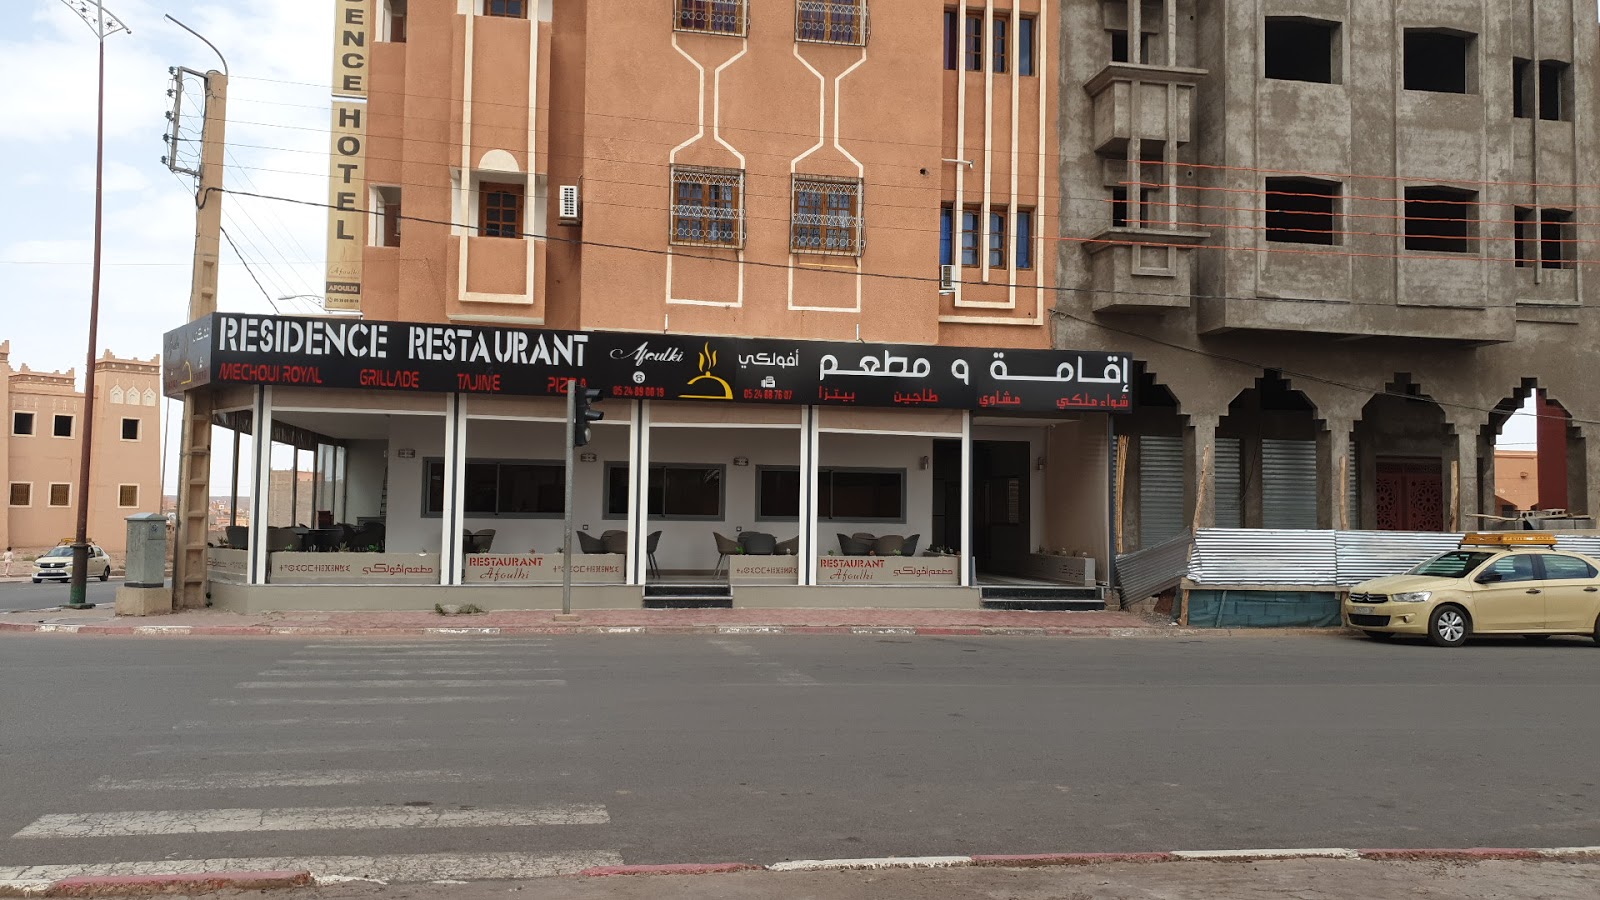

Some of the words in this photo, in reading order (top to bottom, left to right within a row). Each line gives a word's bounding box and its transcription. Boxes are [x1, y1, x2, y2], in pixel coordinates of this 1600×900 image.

[342, 0, 364, 91] ENCE
[336, 107, 361, 240] HOTEL
[219, 317, 388, 359] RESIDENCE
[408, 326, 589, 367] RESTAURANT
[738, 348, 799, 369] أفولكي
[819, 350, 931, 381] مطعم
[219, 362, 280, 381] MECHOUI
[283, 365, 323, 384] ROYAL
[360, 368, 419, 388] GRILLADE
[951, 358, 969, 386] و
[457, 373, 501, 391] TAJINE
[743, 388, 753, 399] 05
[818, 385, 856, 402] بيتزا
[893, 388, 939, 403] طاجين
[979, 389, 1021, 408] مشاوي
[1056, 392, 1098, 409] ملكي
[1099, 393, 1129, 409] شواء
[404, 564, 433, 576] مطعم
[469, 557, 543, 567] RESTAURANT
[820, 559, 885, 568] RESTAURANT
